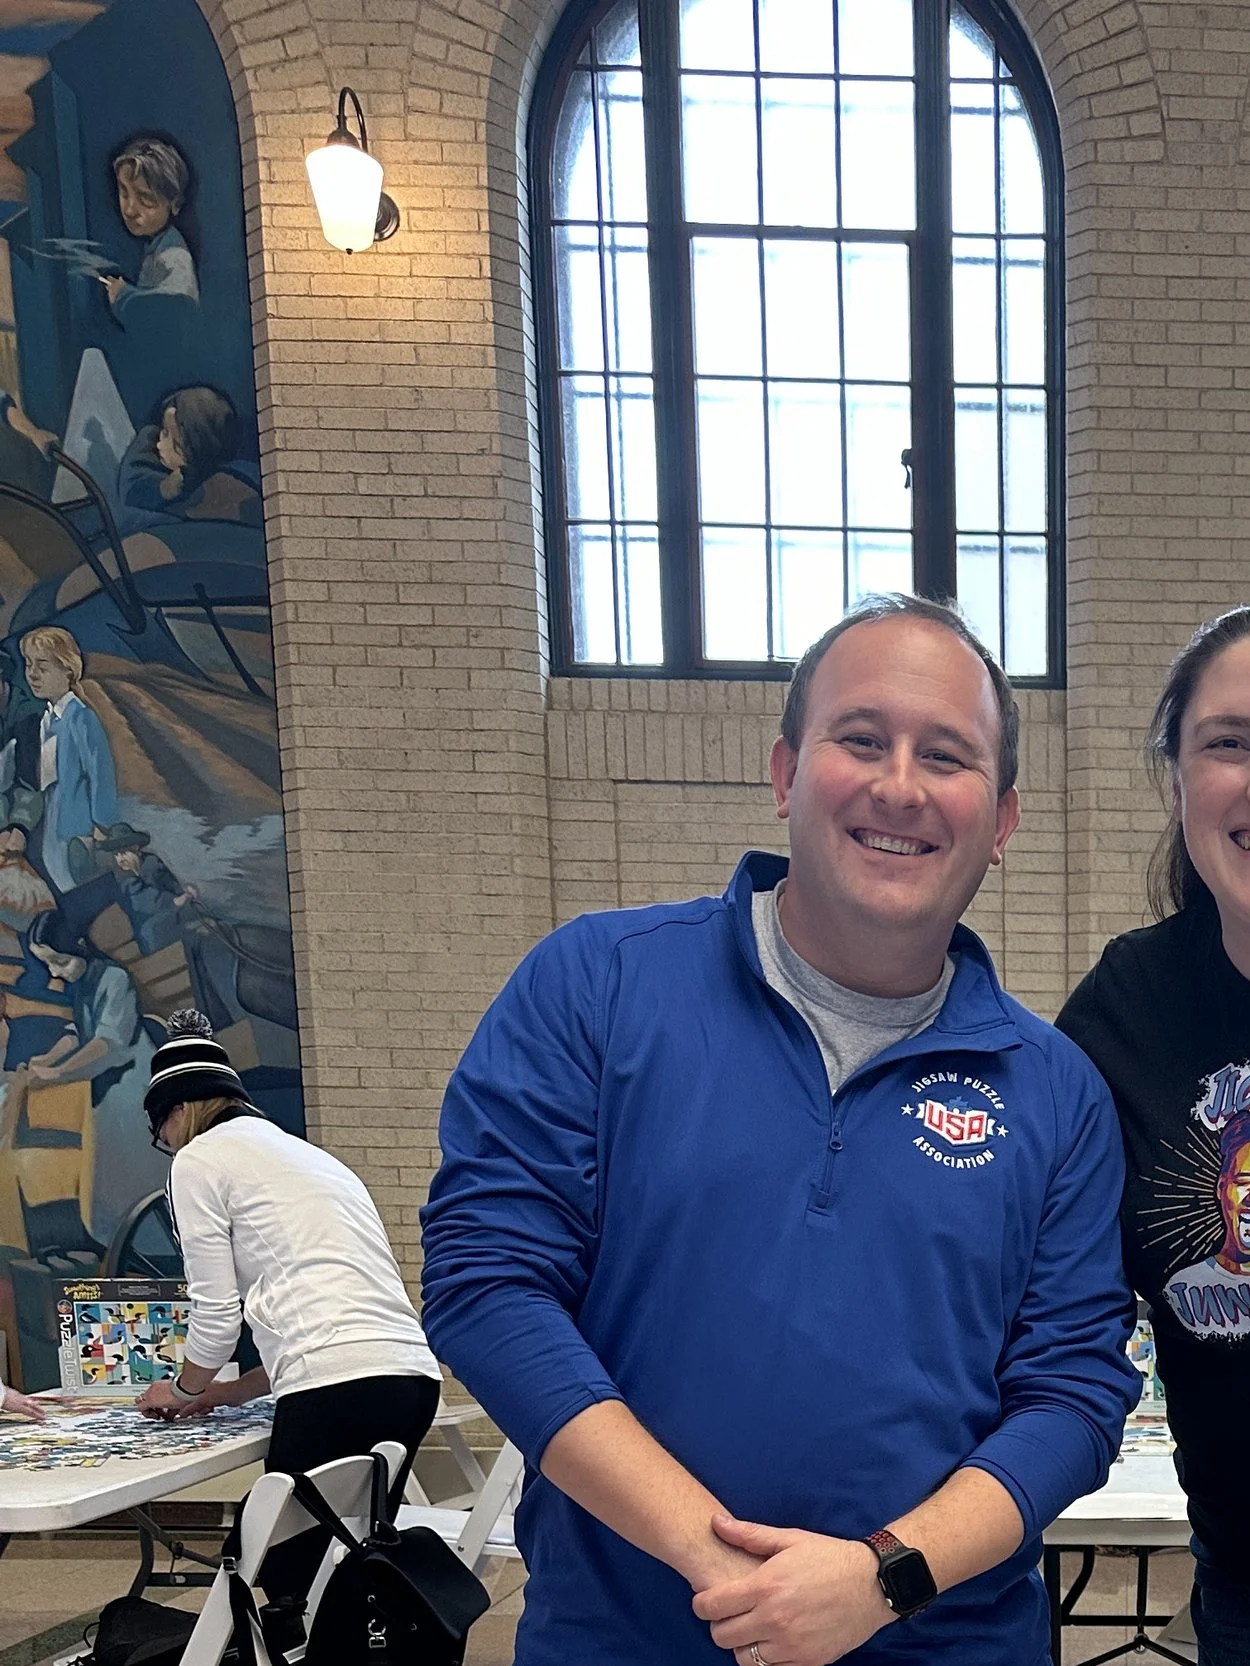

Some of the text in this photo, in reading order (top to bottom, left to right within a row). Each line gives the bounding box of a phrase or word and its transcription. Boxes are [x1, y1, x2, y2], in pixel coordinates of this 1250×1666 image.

[912, 1072, 1005, 1110] JIGSAW PUZZLE
[927, 1101, 985, 1141] USA
[912, 1136, 995, 1168] ASSOCIATION
